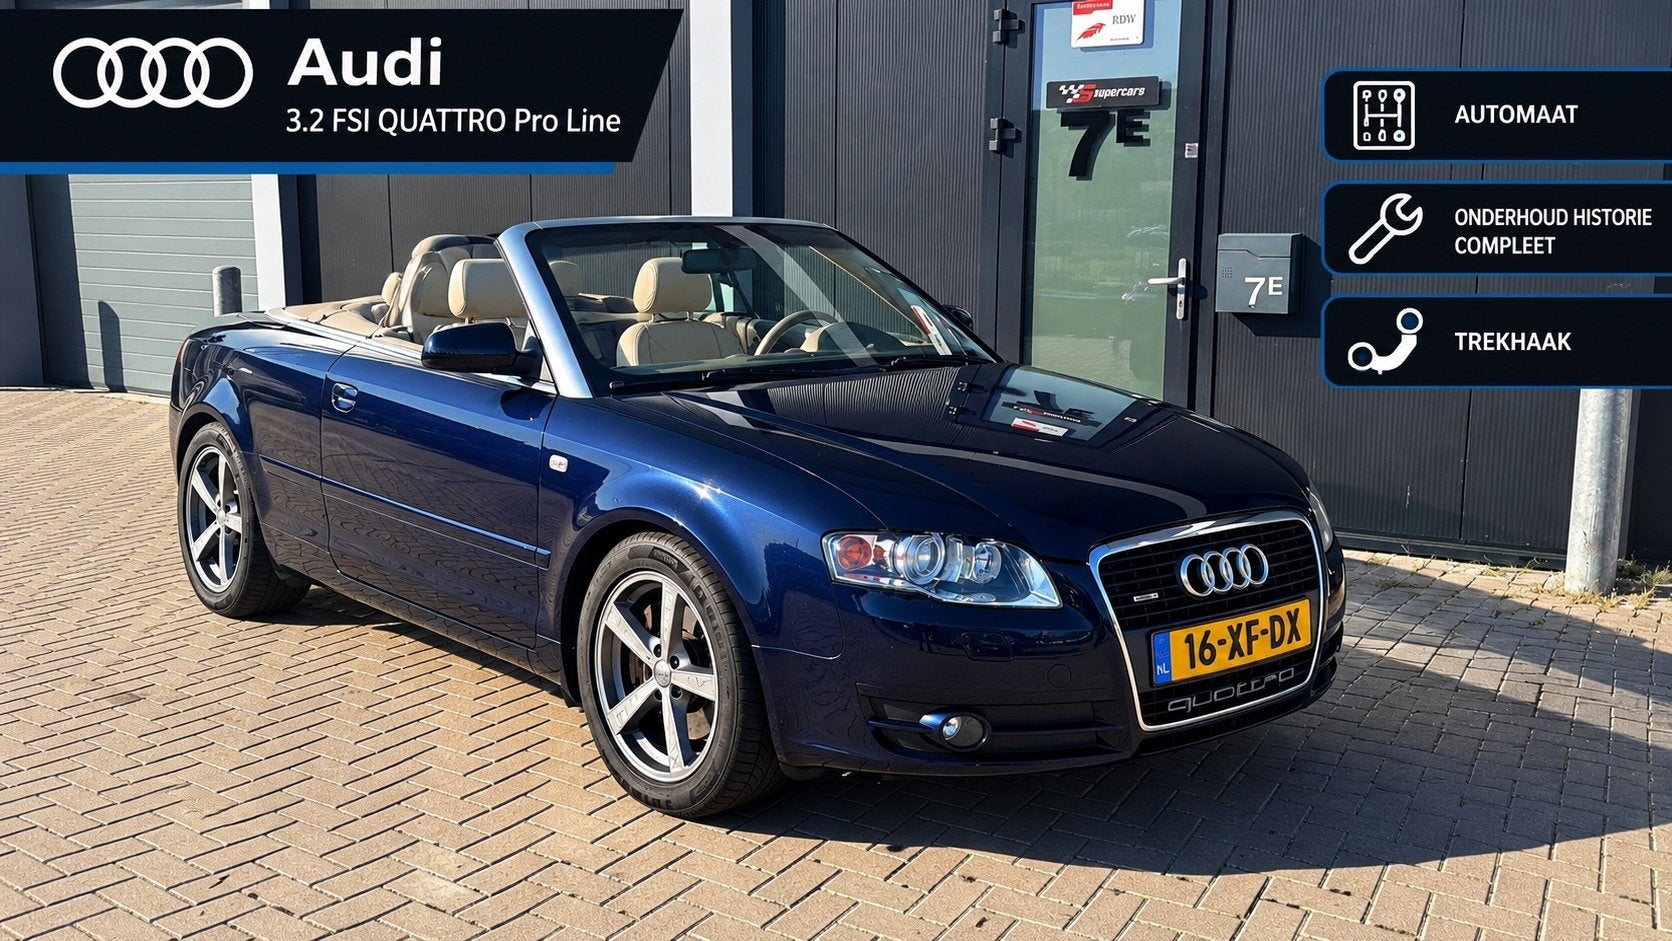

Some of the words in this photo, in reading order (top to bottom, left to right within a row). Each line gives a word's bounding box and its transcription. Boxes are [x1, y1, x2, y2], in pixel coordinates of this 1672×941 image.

[1112, 14, 1137, 25] RDW
[1061, 109, 1146, 177] 7E
[1244, 276, 1283, 308] 7E
[1157, 663, 1170, 675] NL
[1184, 608, 1302, 669] 16-XF-DX
